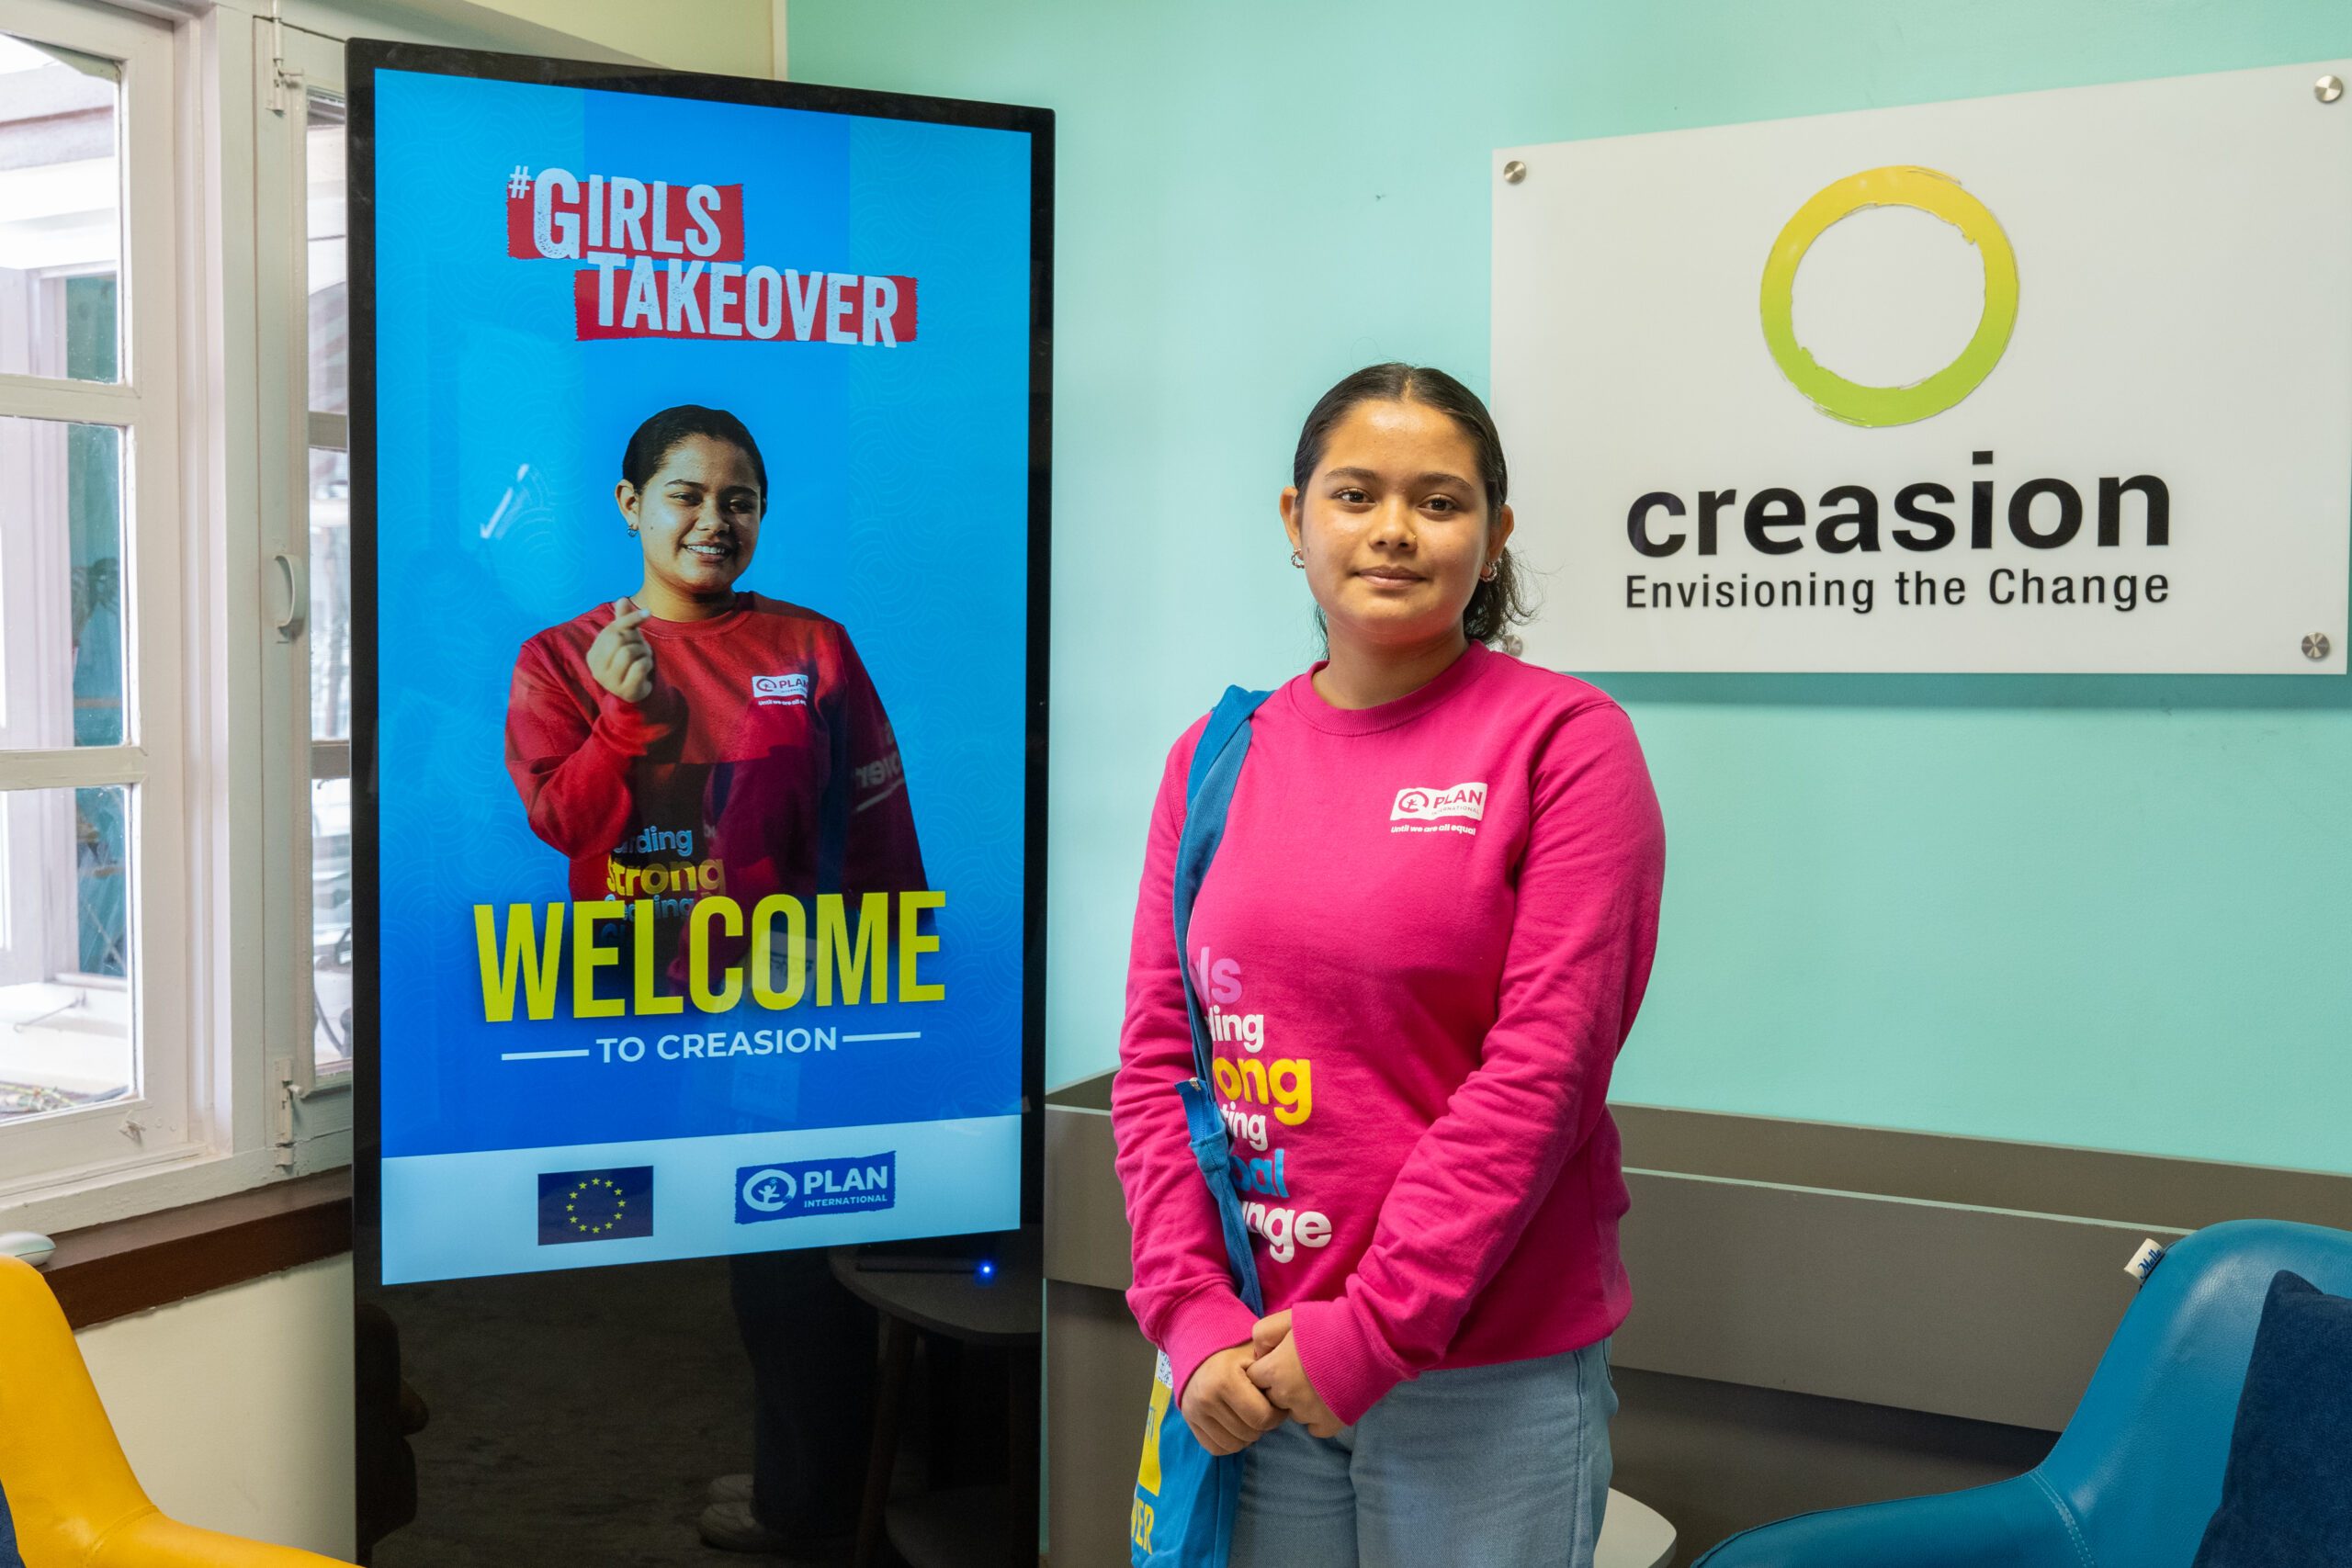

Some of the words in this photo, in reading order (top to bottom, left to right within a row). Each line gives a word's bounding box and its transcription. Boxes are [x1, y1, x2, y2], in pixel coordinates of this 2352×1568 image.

[509, 164, 722, 260] #GIRLS
[587, 251, 899, 349] TAKEOVER
[1626, 450, 2170, 558] creasion
[1625, 571, 1875, 615] Envisioning
[1894, 570, 1967, 605] the
[1987, 568, 2170, 613] Change
[1433, 789, 1484, 809] PLAN
[473, 890, 946, 1022] WELCOME
[594, 1036, 646, 1064] TO
[656, 1026, 837, 1060] CREASION
[803, 1193, 888, 1209] INTERNATIONAL
[804, 1165, 888, 1195] PLAN
